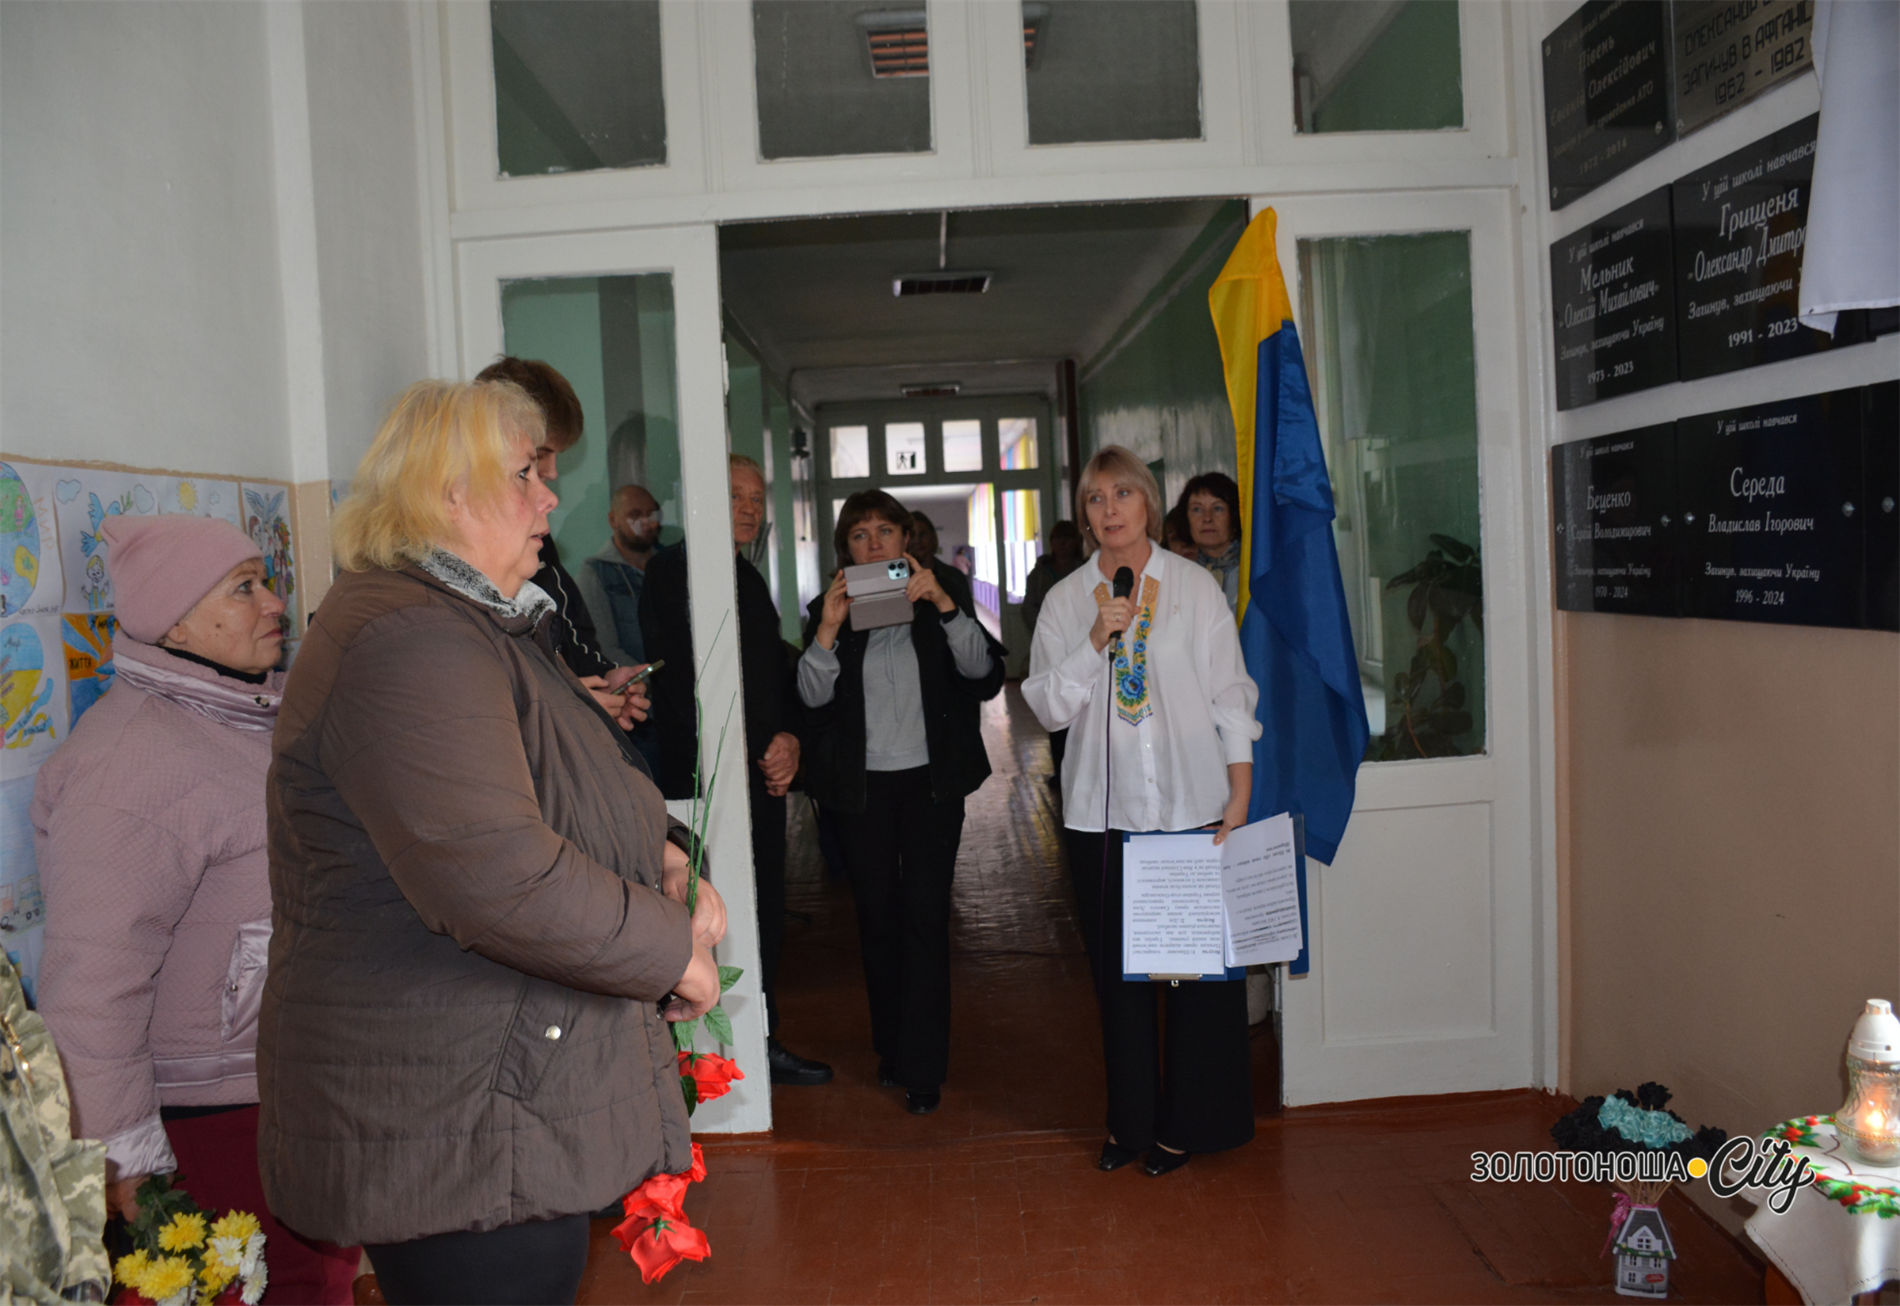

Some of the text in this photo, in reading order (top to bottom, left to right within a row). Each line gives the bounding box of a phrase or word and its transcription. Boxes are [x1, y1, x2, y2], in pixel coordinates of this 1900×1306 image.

[1685, 0, 1757, 57] ОЛЕКСАНДР
[1578, 35, 1615, 74] Півень
[1682, 0, 1812, 96] ЗАГИНУВ В АФГАНІС
[1588, 40, 1656, 99] Олексійович
[1715, 71, 1745, 106] 1962
[1771, 37, 1804, 75] 1982
[1637, 80, 1654, 103] АТО
[1606, 137, 1628, 158] 2014
[1701, 139, 1817, 201] У цій школі навчався
[1719, 187, 1799, 241] Грищеня
[1569, 247, 1574, 263] У
[1588, 231, 1609, 254] школі
[1611, 218, 1644, 242] навчався
[1695, 245, 1753, 283] Олександр
[1756, 225, 1808, 269] Дмитро
[1579, 256, 1635, 294] Мельник
[1564, 281, 1655, 329] Олексій Михайлович
[1688, 277, 1793, 320] Загинув, захищаючи
[1631, 315, 1665, 337] Україну
[1728, 328, 1754, 348] 1991
[1767, 317, 1799, 338] 2023
[1587, 369, 1605, 385] 1973
[1613, 361, 1634, 378] 2023
[1717, 413, 1798, 436] У цій школі навчався
[1586, 485, 1632, 515] Беценко
[1729, 466, 1786, 503] Середа
[34, 497, 55, 550] МИР
[1571, 522, 1652, 543] Сергій Володимирович
[1708, 510, 1815, 536] Владислав Ігорович
[1627, 563, 1652, 578] Україну
[1738, 566, 1783, 580] захищаючи
[1785, 563, 1821, 583] Україну
[1595, 586, 1608, 598] 1970
[1613, 586, 1629, 598] 2024
[1735, 588, 1754, 604] 1996
[1762, 589, 1785, 606] 2024
[69, 657, 92, 670] ЖИТТЯ
